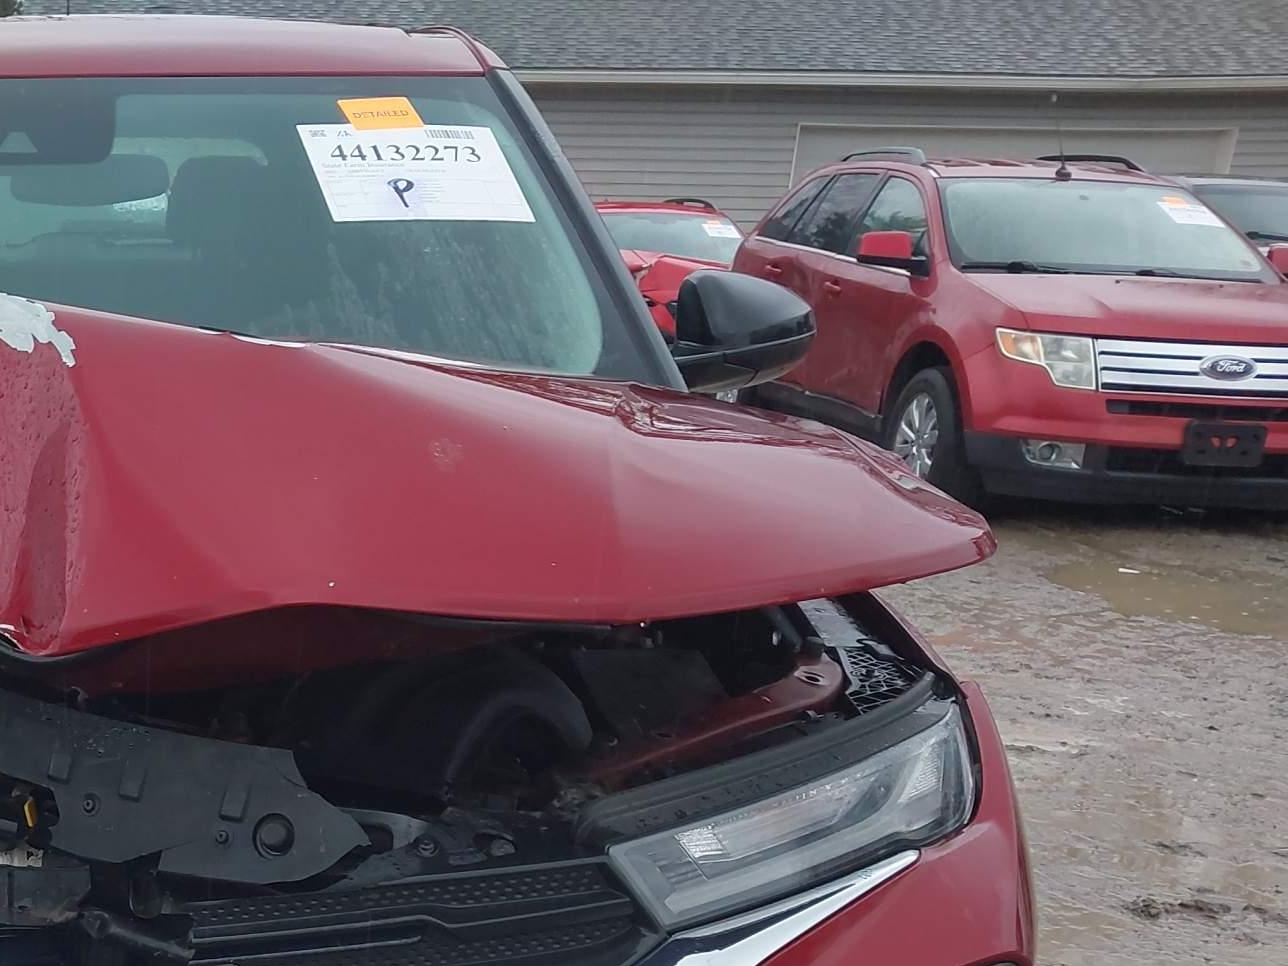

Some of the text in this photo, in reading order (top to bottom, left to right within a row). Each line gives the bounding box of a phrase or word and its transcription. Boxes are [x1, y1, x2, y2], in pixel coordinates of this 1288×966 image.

[329, 144, 481, 163] 44132273
[386, 178, 415, 208] P
[1216, 359, 1247, 373] Ford
